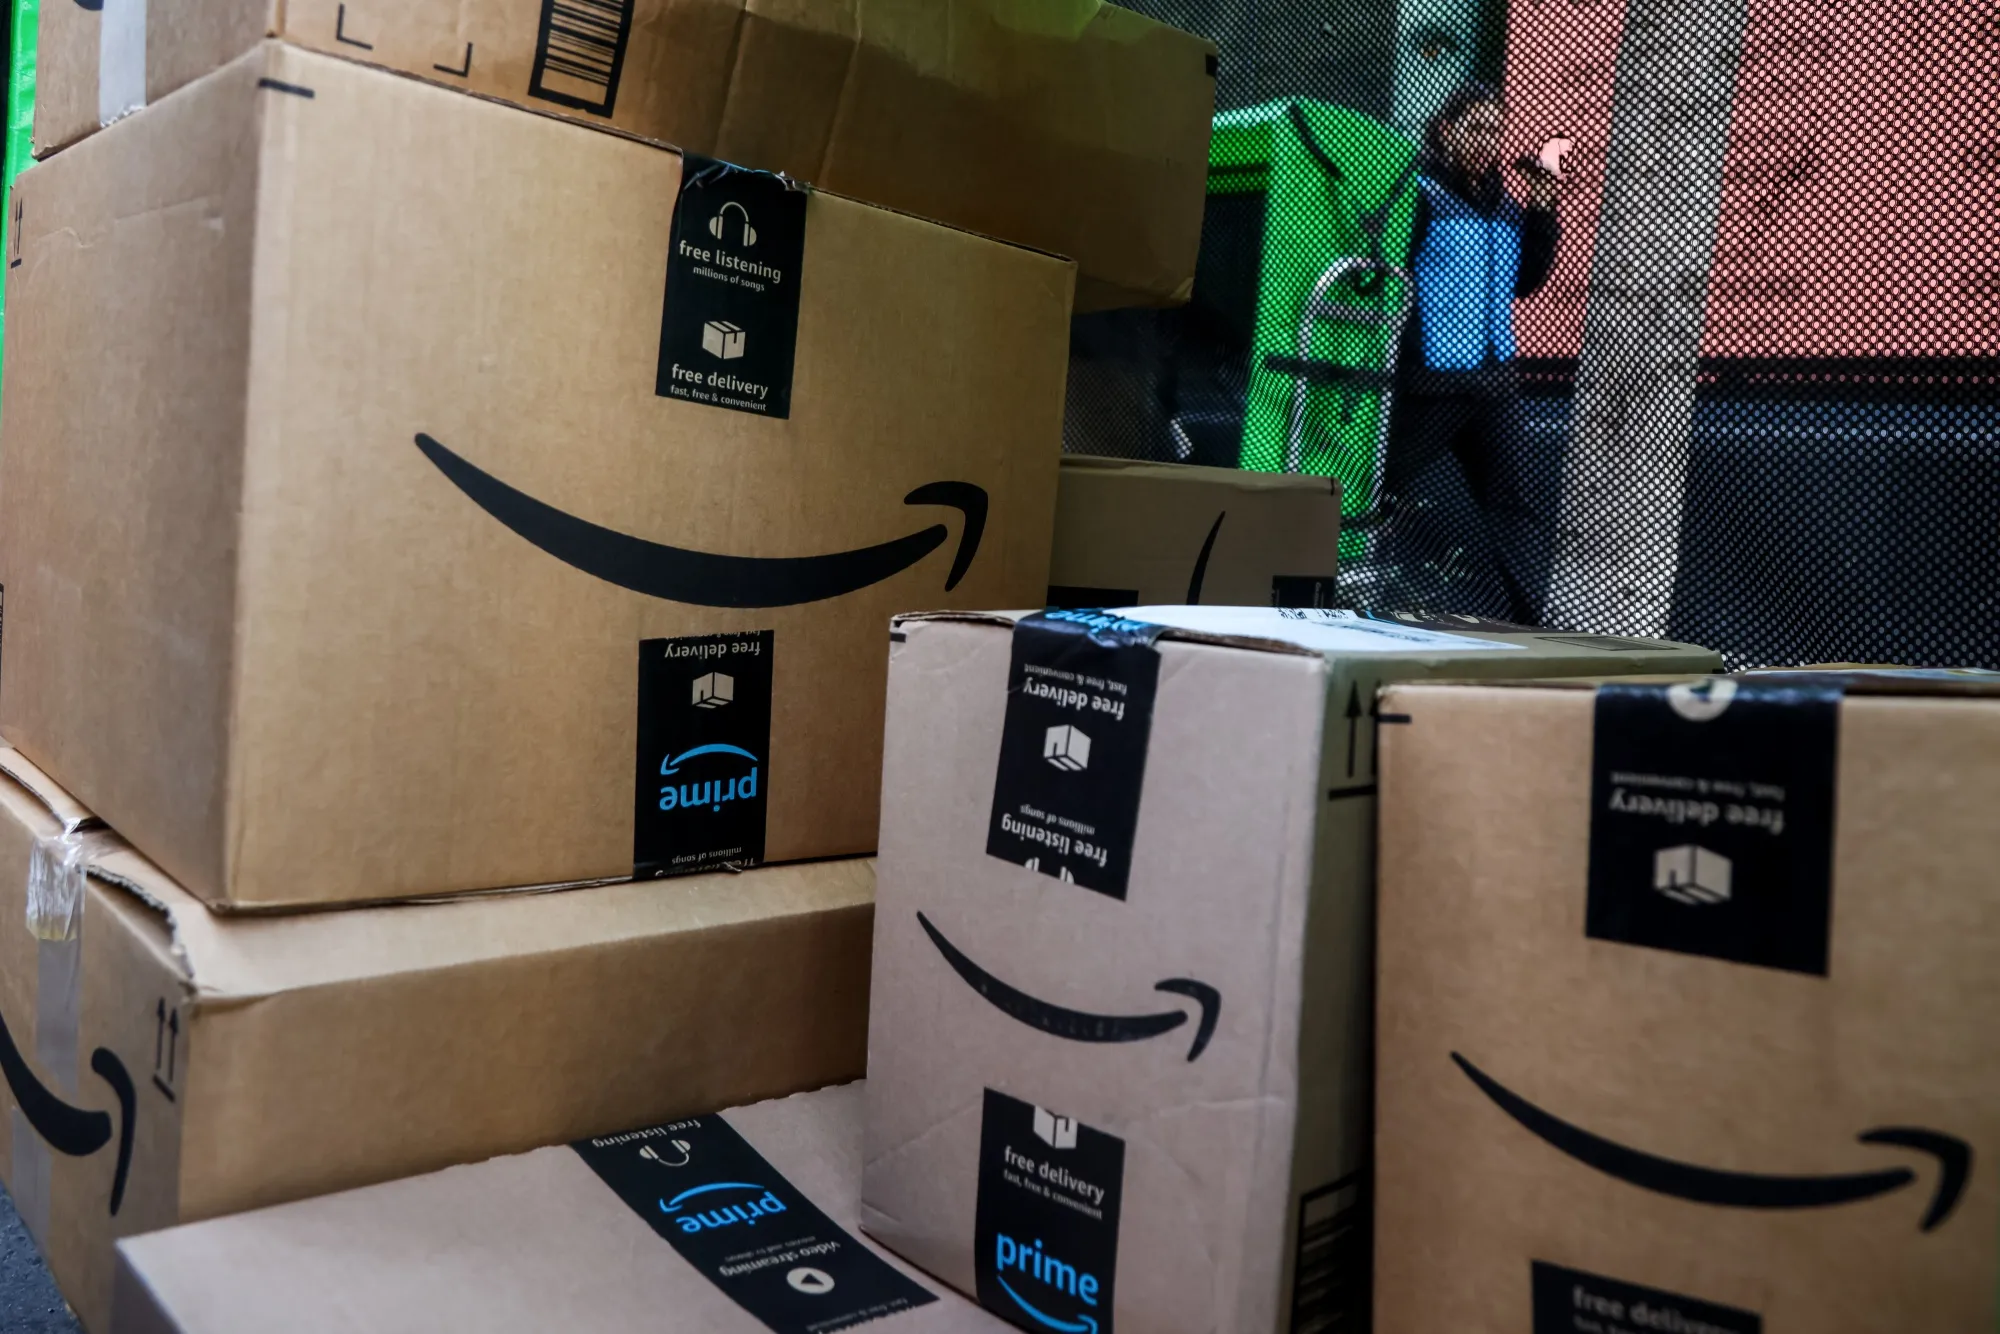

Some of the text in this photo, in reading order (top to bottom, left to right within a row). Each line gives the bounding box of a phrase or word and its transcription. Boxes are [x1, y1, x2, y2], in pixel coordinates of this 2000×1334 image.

[679, 240, 781, 284] free listening
[693, 266, 765, 292] millions of songs
[670, 384, 767, 411] fast, free & convenient
[672, 363, 768, 400] free delivery
[664, 641, 761, 660] free delivery
[1024, 663, 1075, 681] convenient
[1076, 673, 1085, 685] &
[1023, 677, 1125, 721] free delivery
[659, 767, 758, 812] prime
[1046, 813, 1057, 825] of
[1058, 816, 1096, 835] millions
[1608, 787, 1785, 836] free delivery
[671, 847, 742, 865] millions of songs
[1001, 812, 1108, 868] free listening
[591, 1119, 701, 1148] free listening
[1004, 1145, 1105, 1206] free delivery
[675, 1191, 788, 1233] prime
[719, 1240, 841, 1278] video streaming
[996, 1232, 1099, 1306] prime
[1572, 1284, 1625, 1320] free
